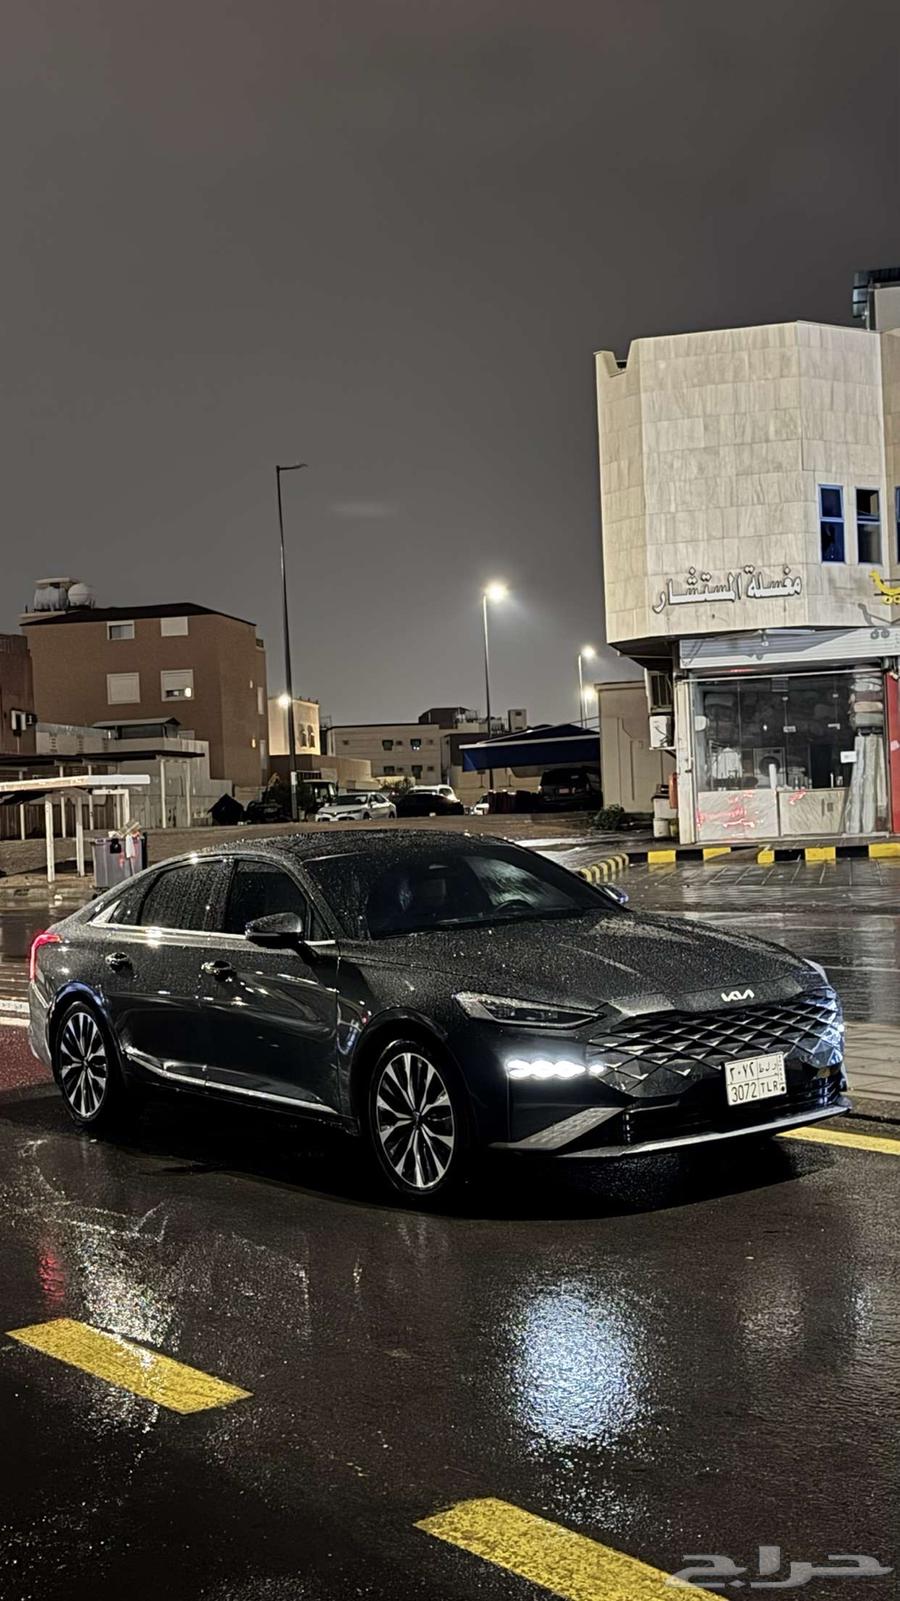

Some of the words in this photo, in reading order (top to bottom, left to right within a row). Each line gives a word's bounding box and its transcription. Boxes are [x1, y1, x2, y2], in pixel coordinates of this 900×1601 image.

[652, 566, 742, 614] المستشار
[744, 564, 802, 599] مغسلة
[731, 1082, 757, 1103] 3072
[760, 1080, 778, 1094] TLR
